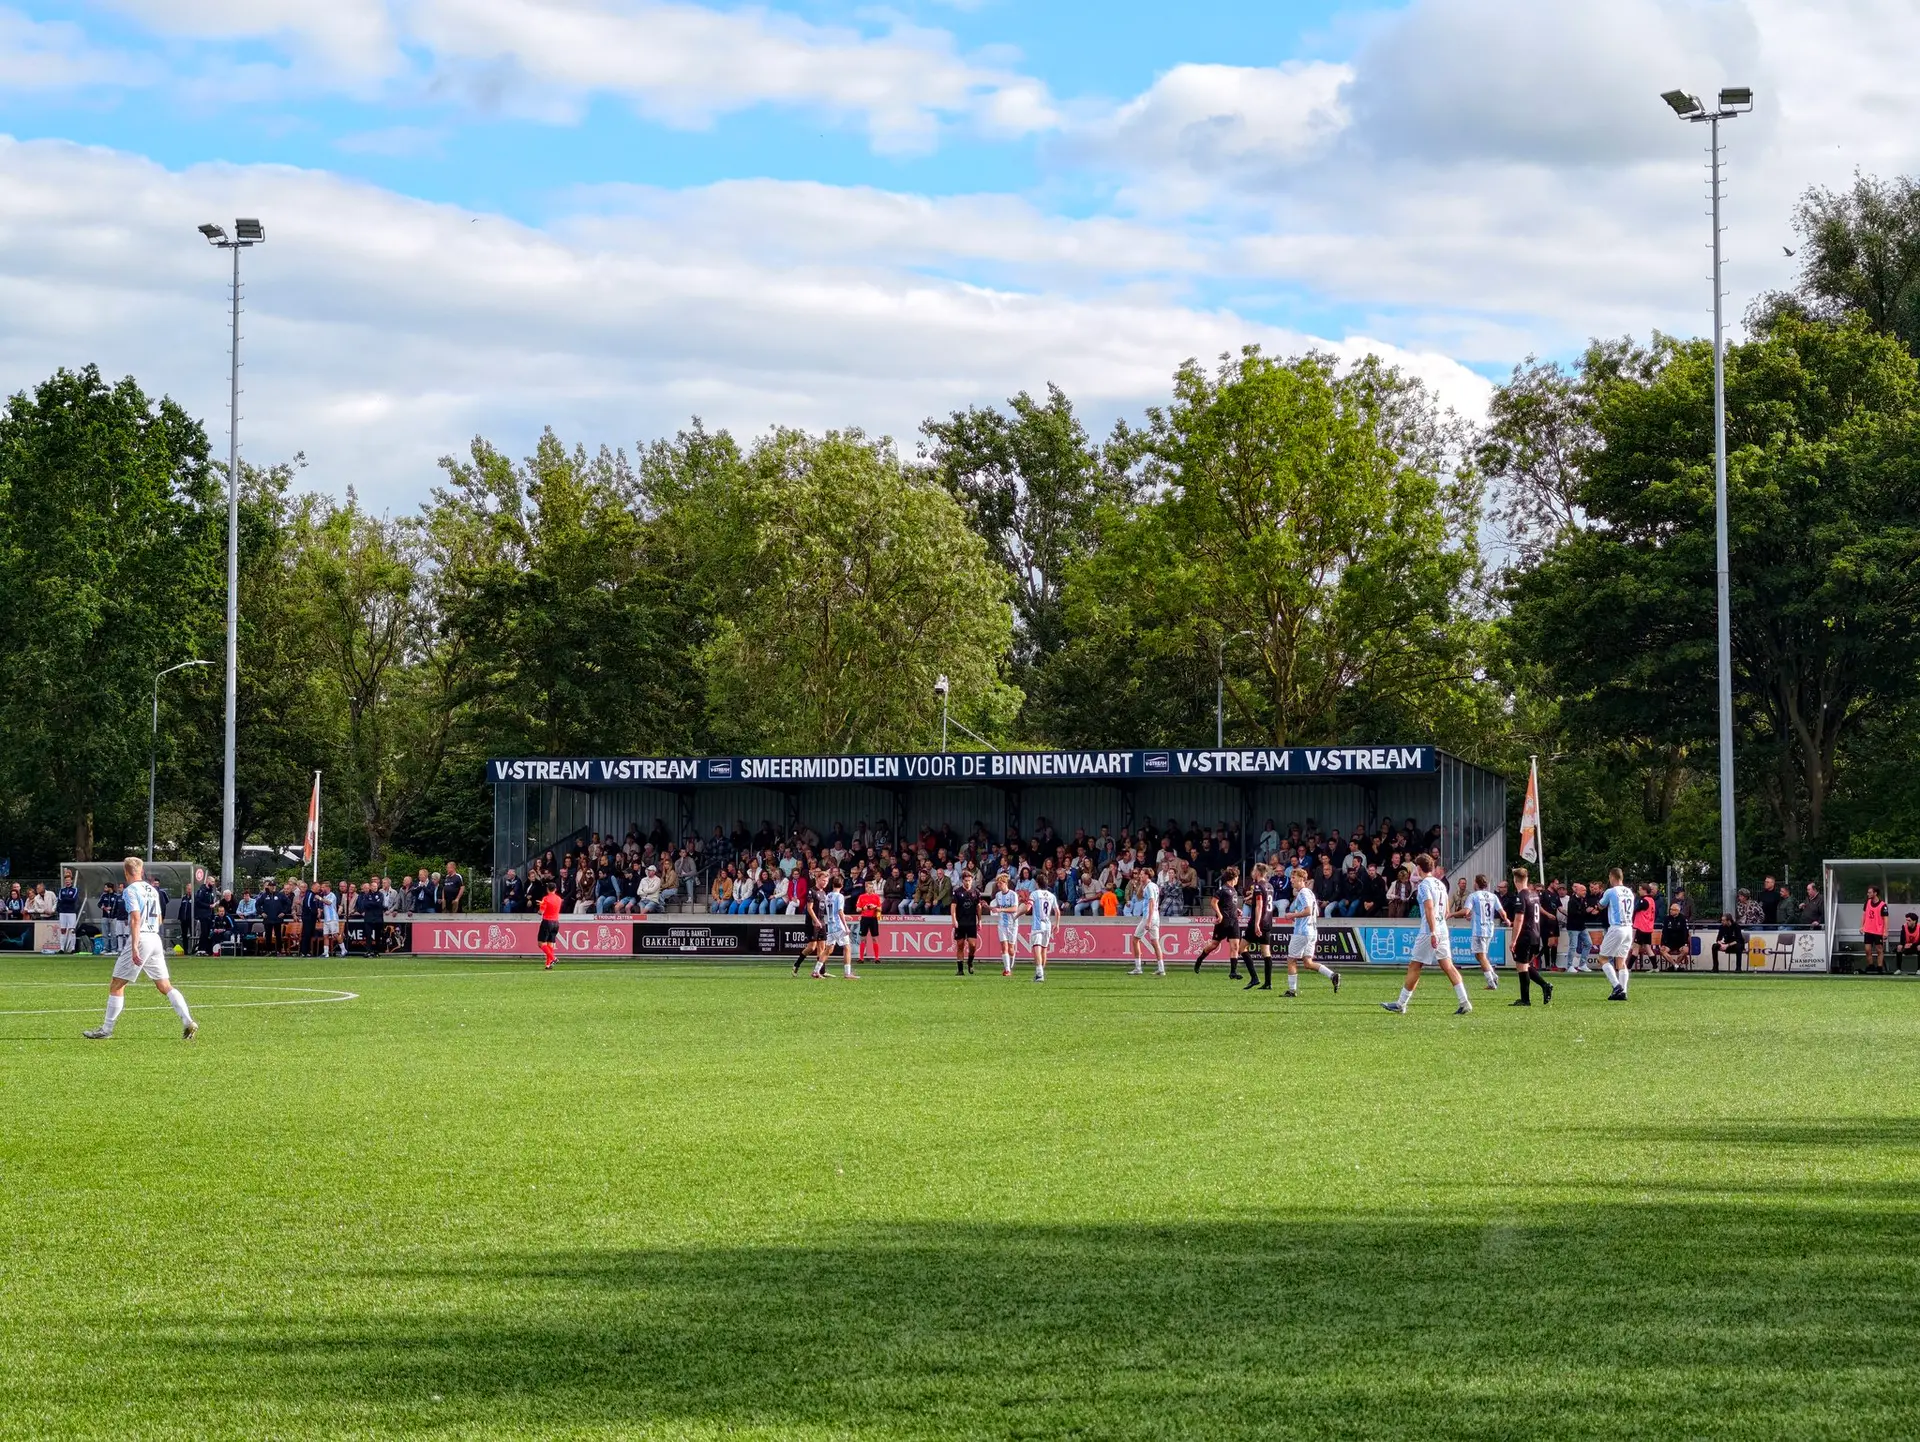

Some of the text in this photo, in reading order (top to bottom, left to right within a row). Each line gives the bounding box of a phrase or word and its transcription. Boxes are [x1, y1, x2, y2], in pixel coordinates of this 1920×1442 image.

[740, 753, 1133, 778] SMEERMIDDELEN VOOR DE BINNENVAART
[146, 900, 157, 921] 14
[1267, 895, 1273, 912] 3
[1485, 903, 1491, 917] 3
[1534, 903, 1540, 923] 9
[1622, 898, 1632, 913] 12
[433, 929, 481, 949] ING
[554, 930, 590, 950] NG
[645, 938, 735, 946] BAKKERIJ KORTEWEG
[785, 932, 790, 941] T
[890, 931, 944, 953] ING
